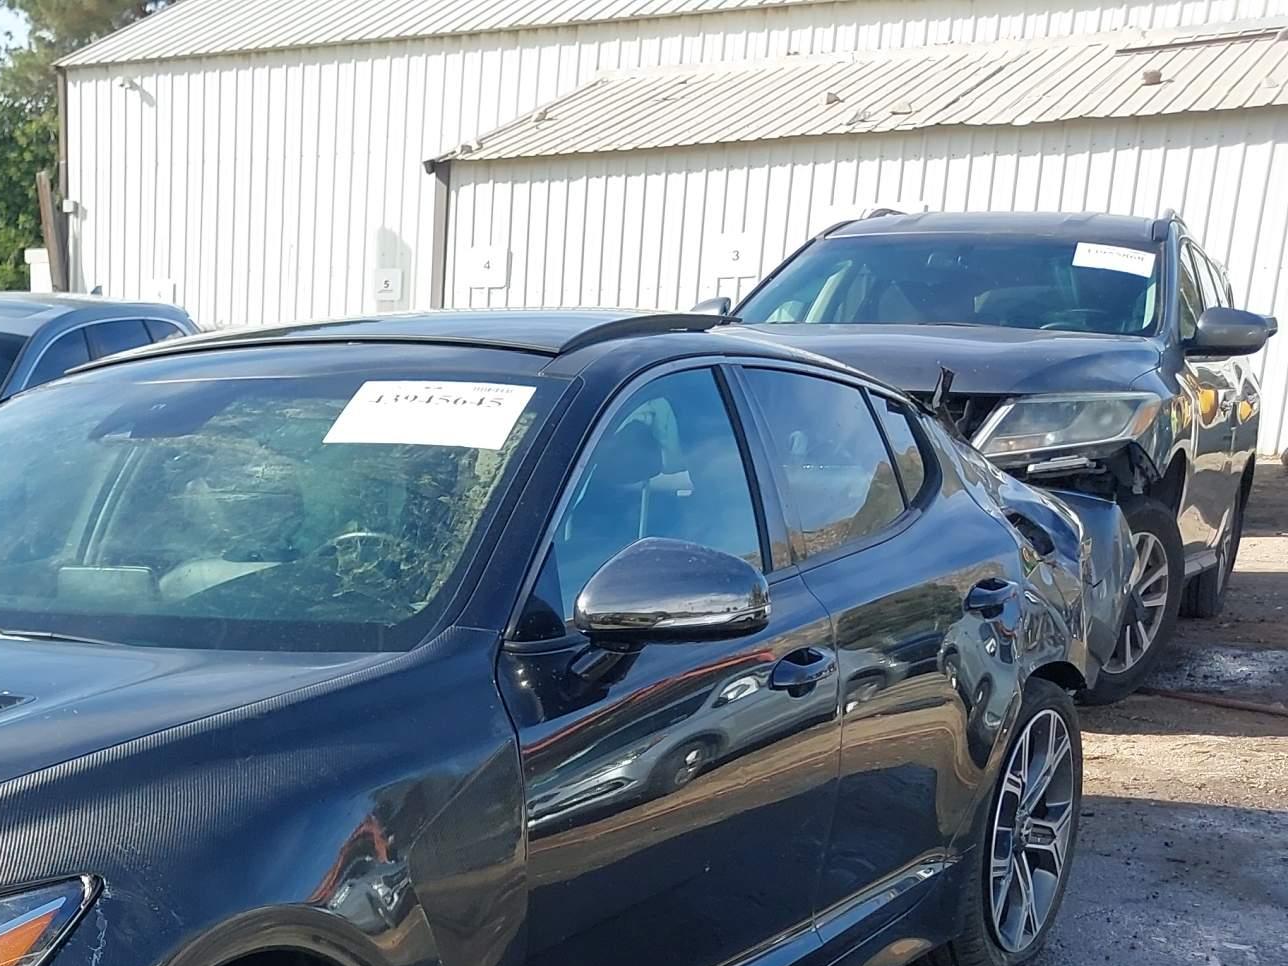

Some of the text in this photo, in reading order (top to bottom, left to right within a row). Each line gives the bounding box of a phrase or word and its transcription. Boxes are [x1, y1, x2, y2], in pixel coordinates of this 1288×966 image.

[731, 249, 740, 261] 3
[483, 260, 491, 270] 4
[383, 279, 390, 289] 5
